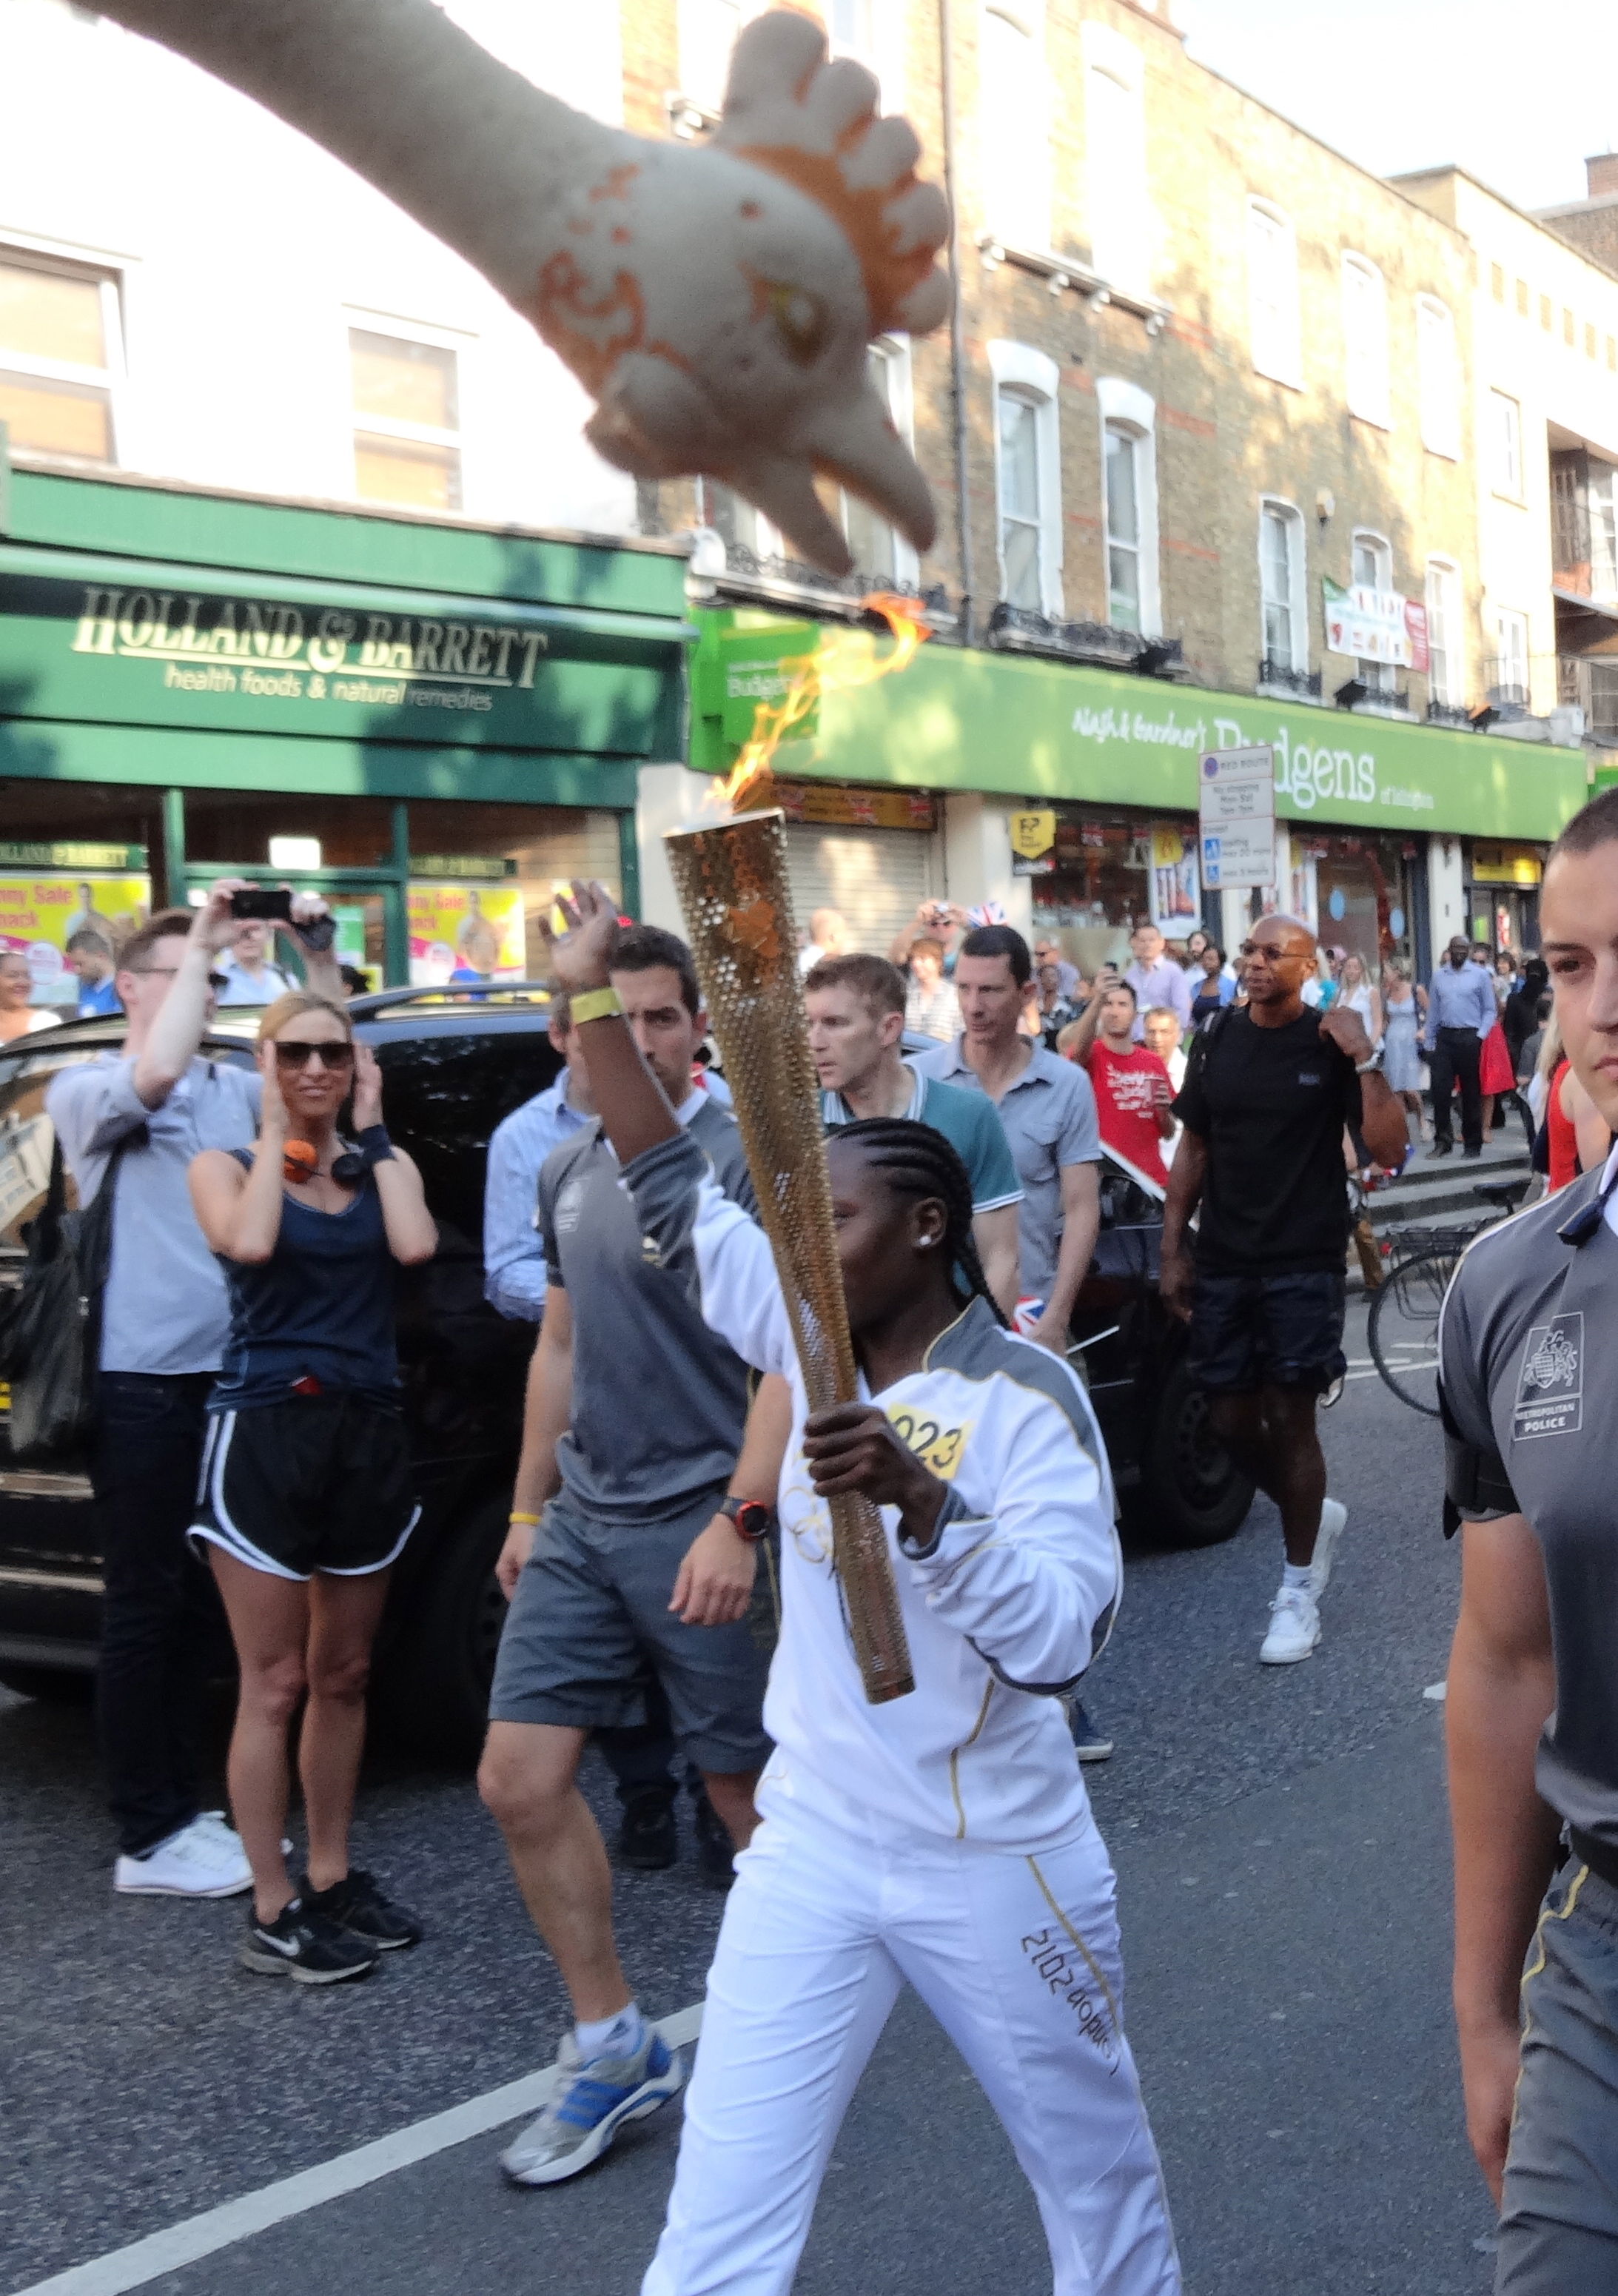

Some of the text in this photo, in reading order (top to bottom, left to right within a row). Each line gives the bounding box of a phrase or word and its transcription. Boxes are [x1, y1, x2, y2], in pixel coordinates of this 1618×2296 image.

[71, 587, 549, 689] HOLLAND & BARRETT
[164, 660, 493, 712] health foods & natural remedies
[1213, 716, 1376, 810] Bdgens
[1221, 757, 1269, 771] RED ROUTE
[33, 885, 72, 905] Sale
[1525, 1416, 1566, 1433] POLICE
[1020, 1929, 1074, 1995] 2012
